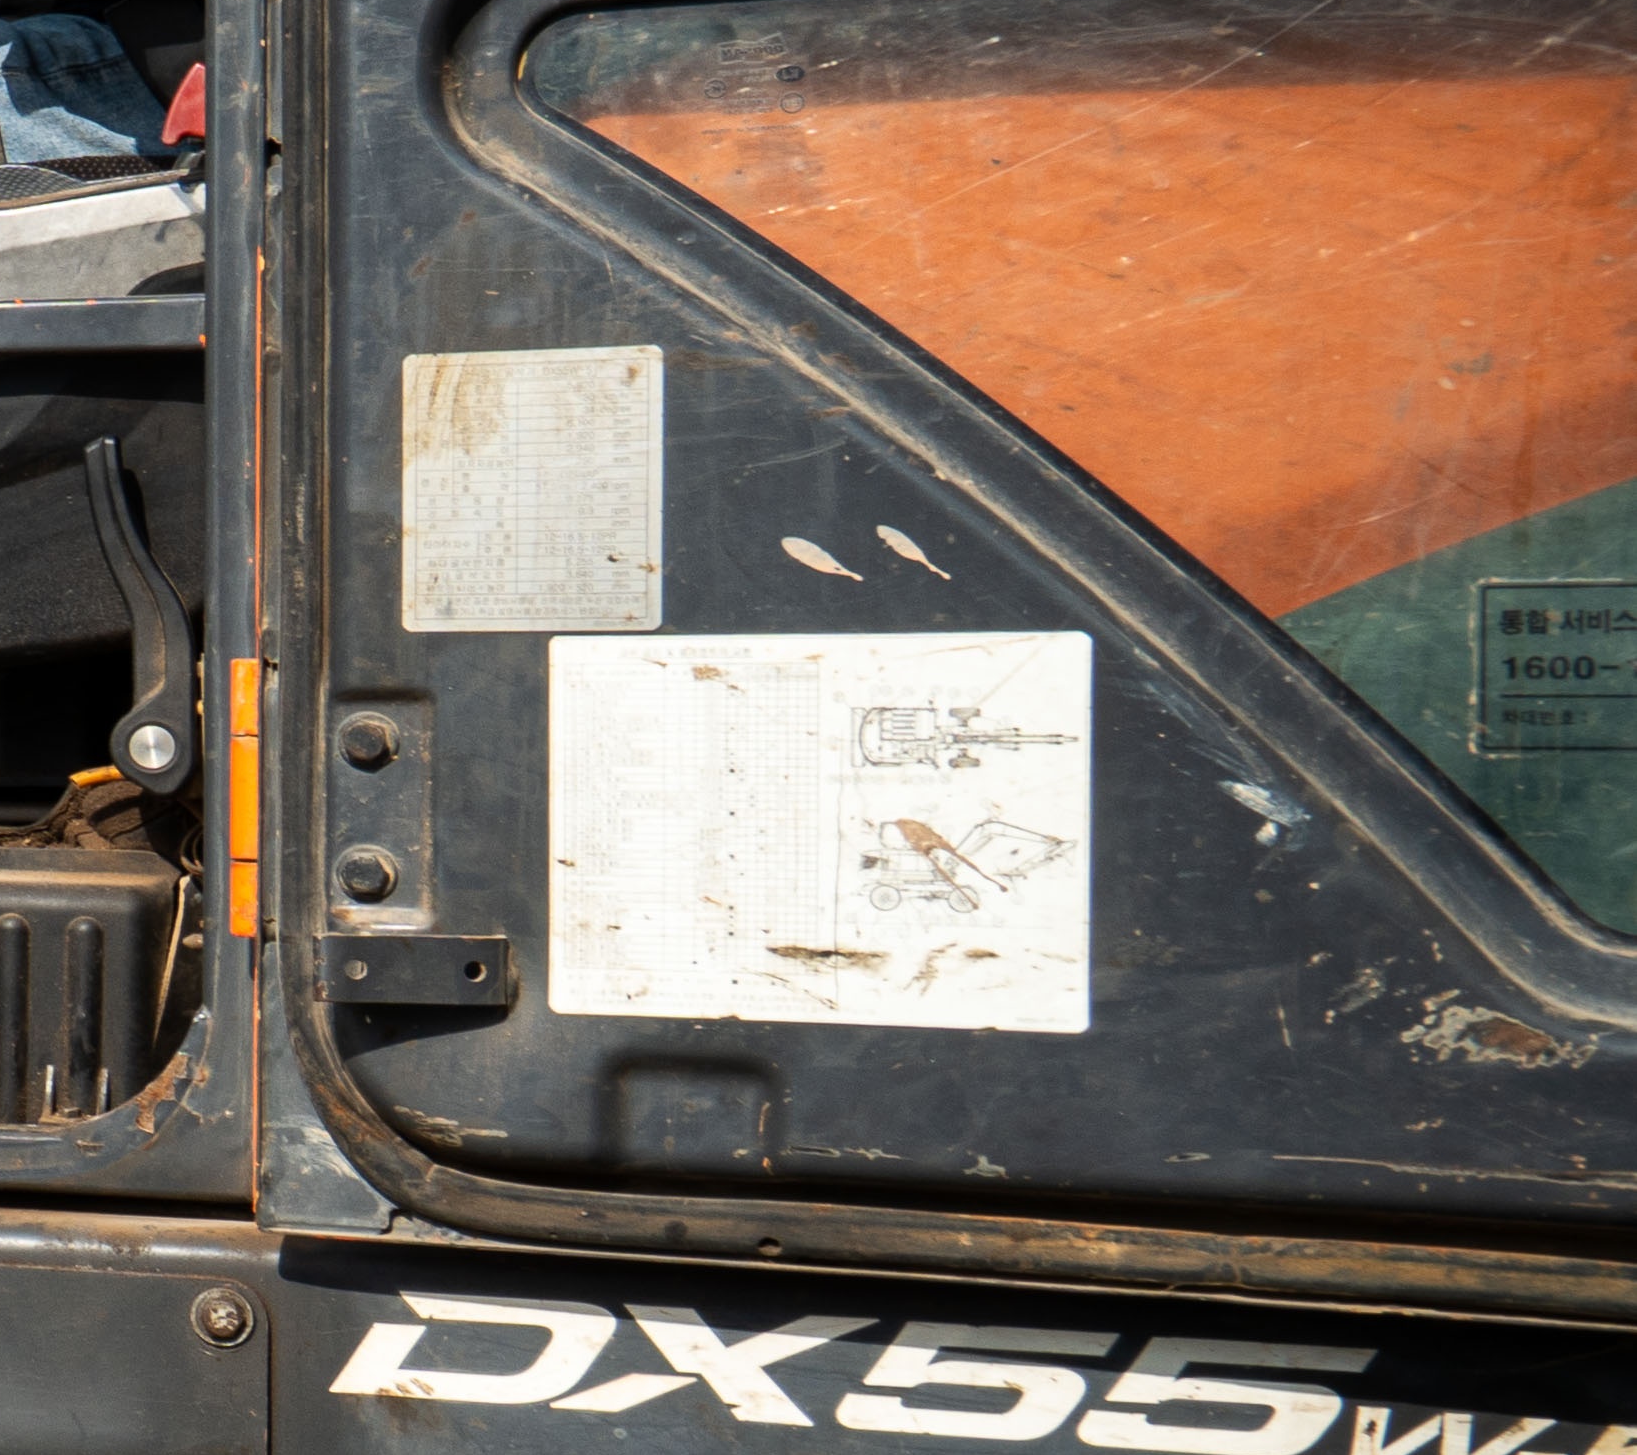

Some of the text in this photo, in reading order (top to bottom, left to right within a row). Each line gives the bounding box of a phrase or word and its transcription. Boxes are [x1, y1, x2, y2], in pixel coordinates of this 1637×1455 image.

[1501, 608, 1637, 636] 통합 서비스
[1501, 655, 1637, 680] 1600-
